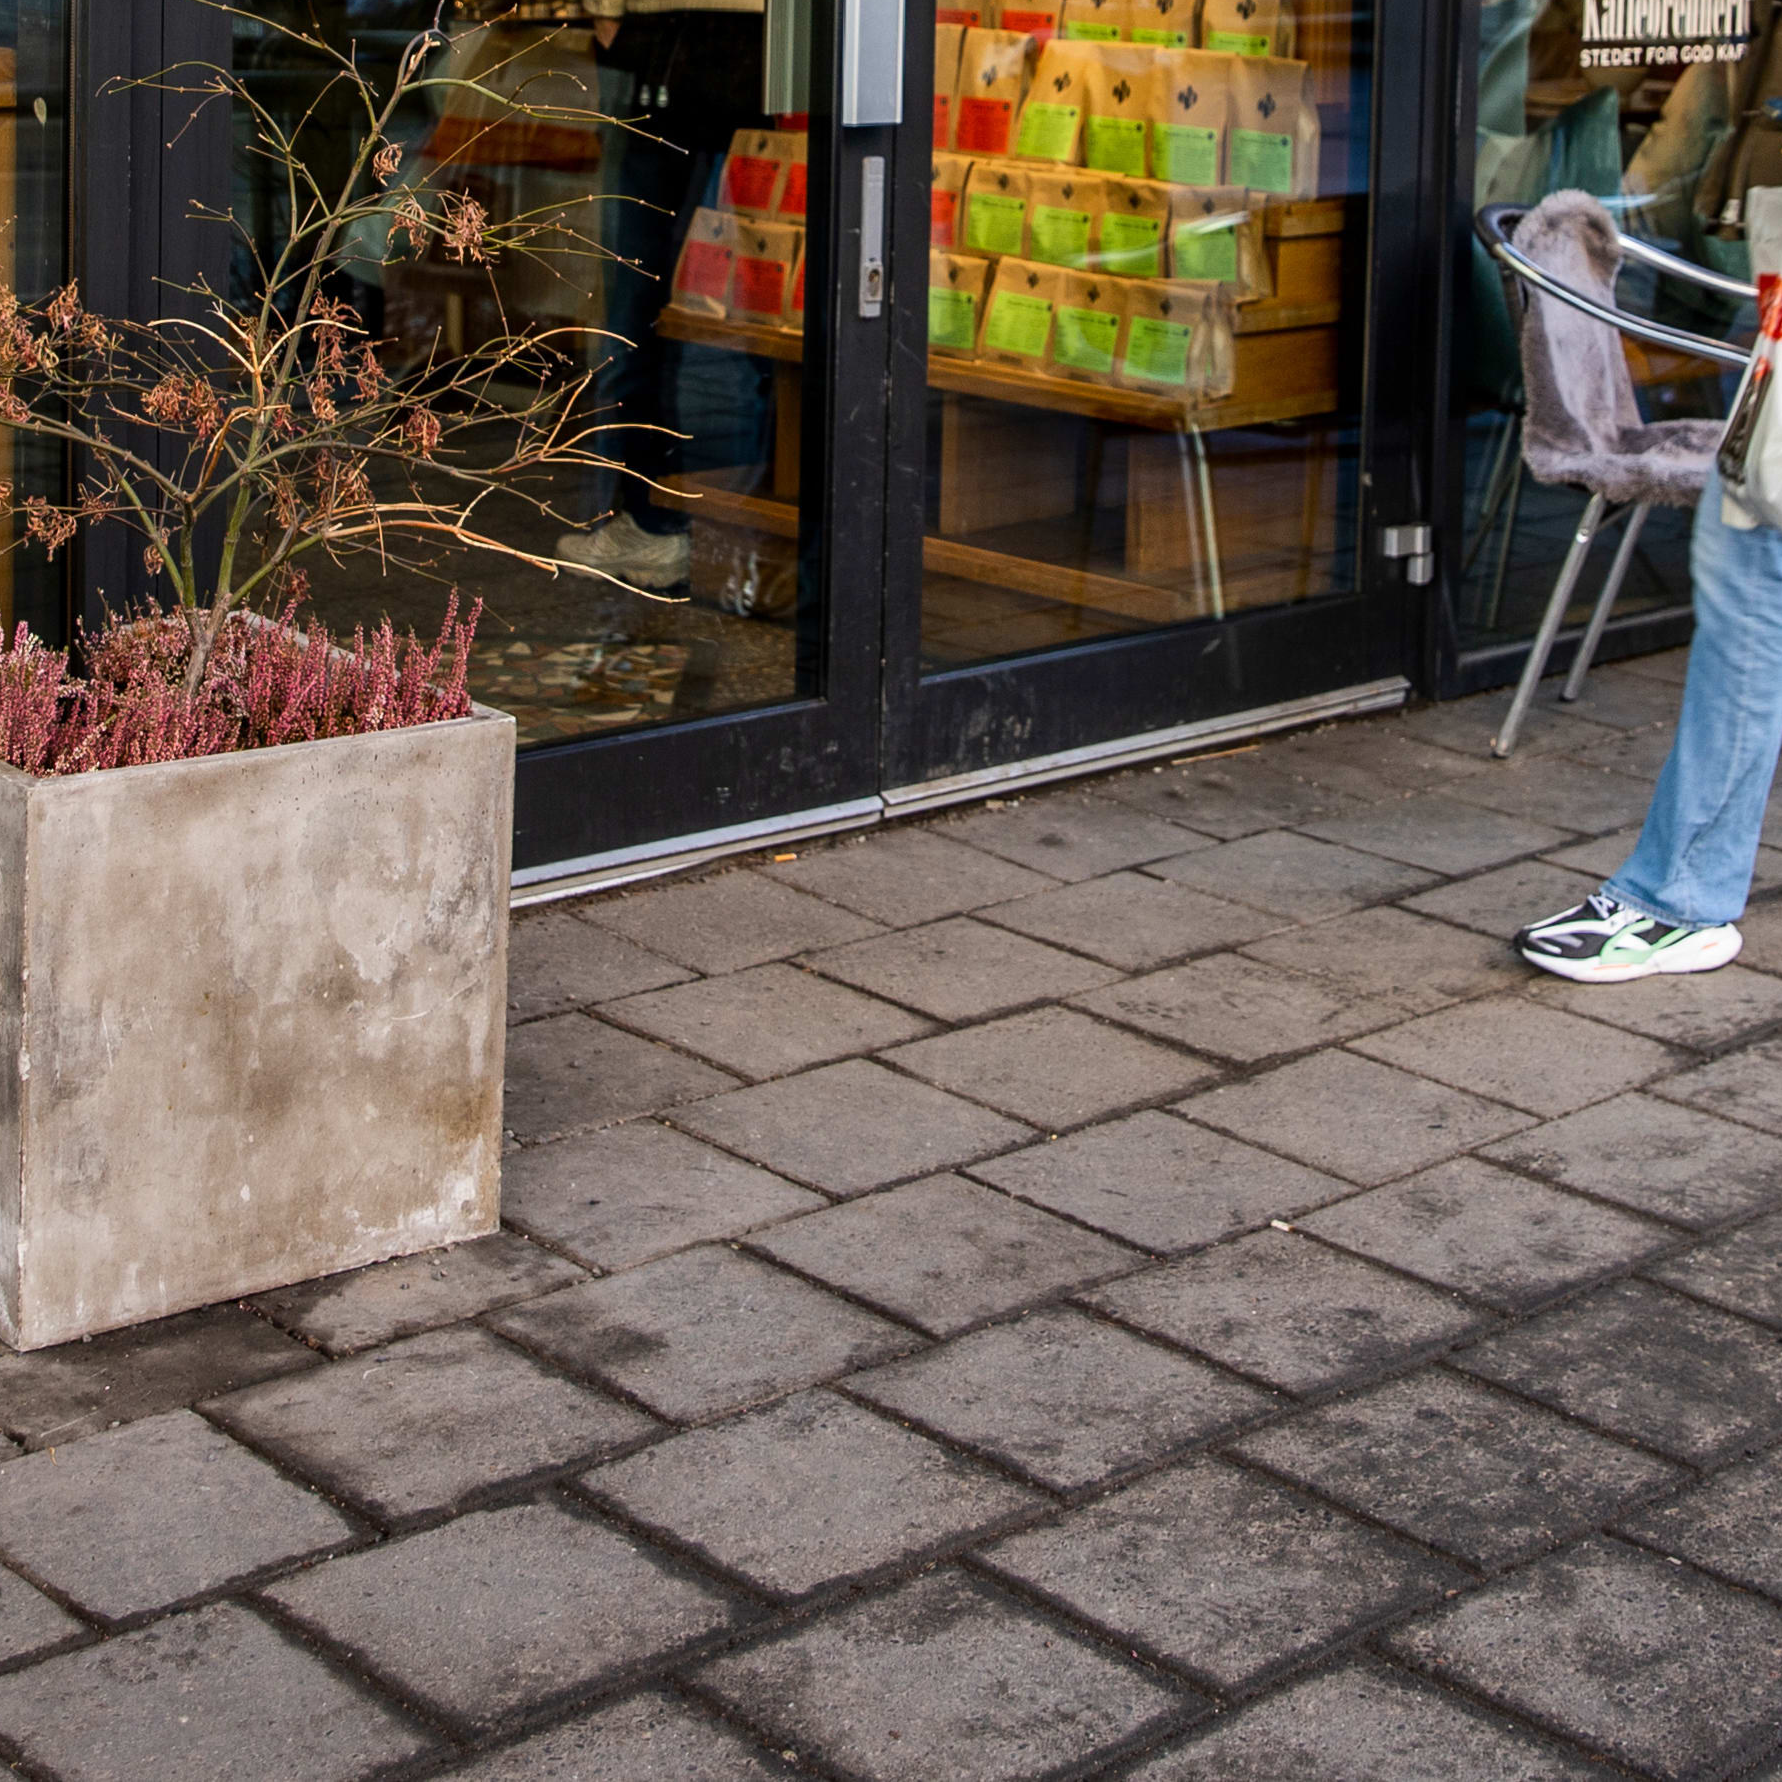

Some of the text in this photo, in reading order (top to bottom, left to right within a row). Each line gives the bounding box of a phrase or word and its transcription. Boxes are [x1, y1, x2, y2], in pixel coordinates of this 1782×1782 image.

[1579, 46, 1643, 68] STEDET
[1645, 45, 1678, 65] FOR
[1680, 43, 1715, 63] GOD
